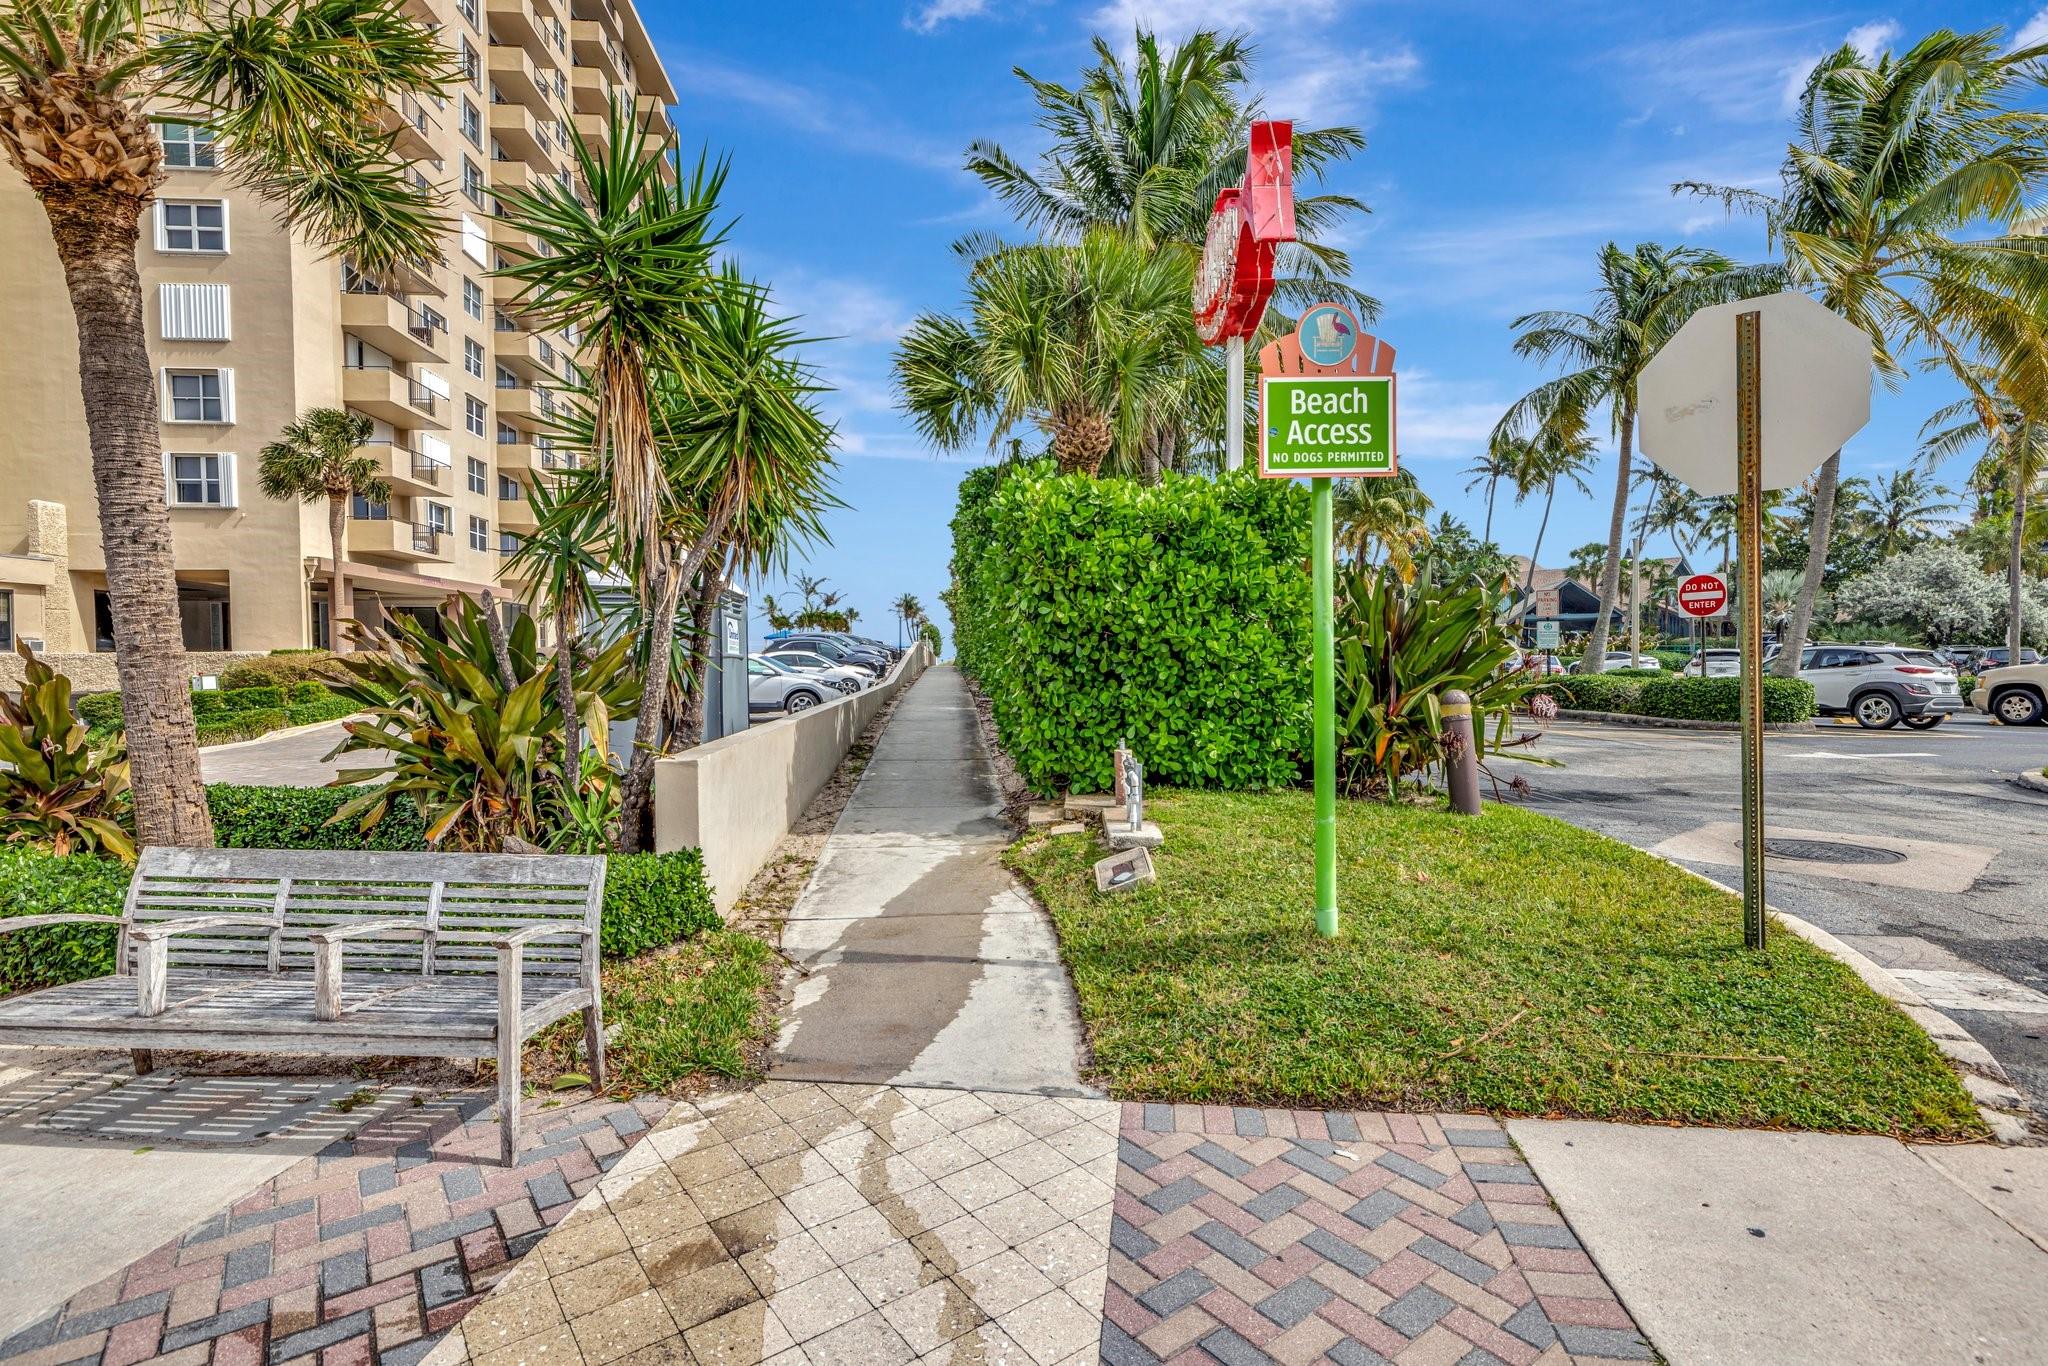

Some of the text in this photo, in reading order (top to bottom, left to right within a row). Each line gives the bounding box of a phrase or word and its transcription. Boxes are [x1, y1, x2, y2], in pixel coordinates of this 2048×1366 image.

[1291, 387, 1368, 414] Beach
[1286, 420, 1373, 445] Access
[1272, 451, 1384, 463] NO DOGS PERMITTED
[1701, 582, 1719, 590] NOT
[1689, 601, 1716, 609] ENTER
